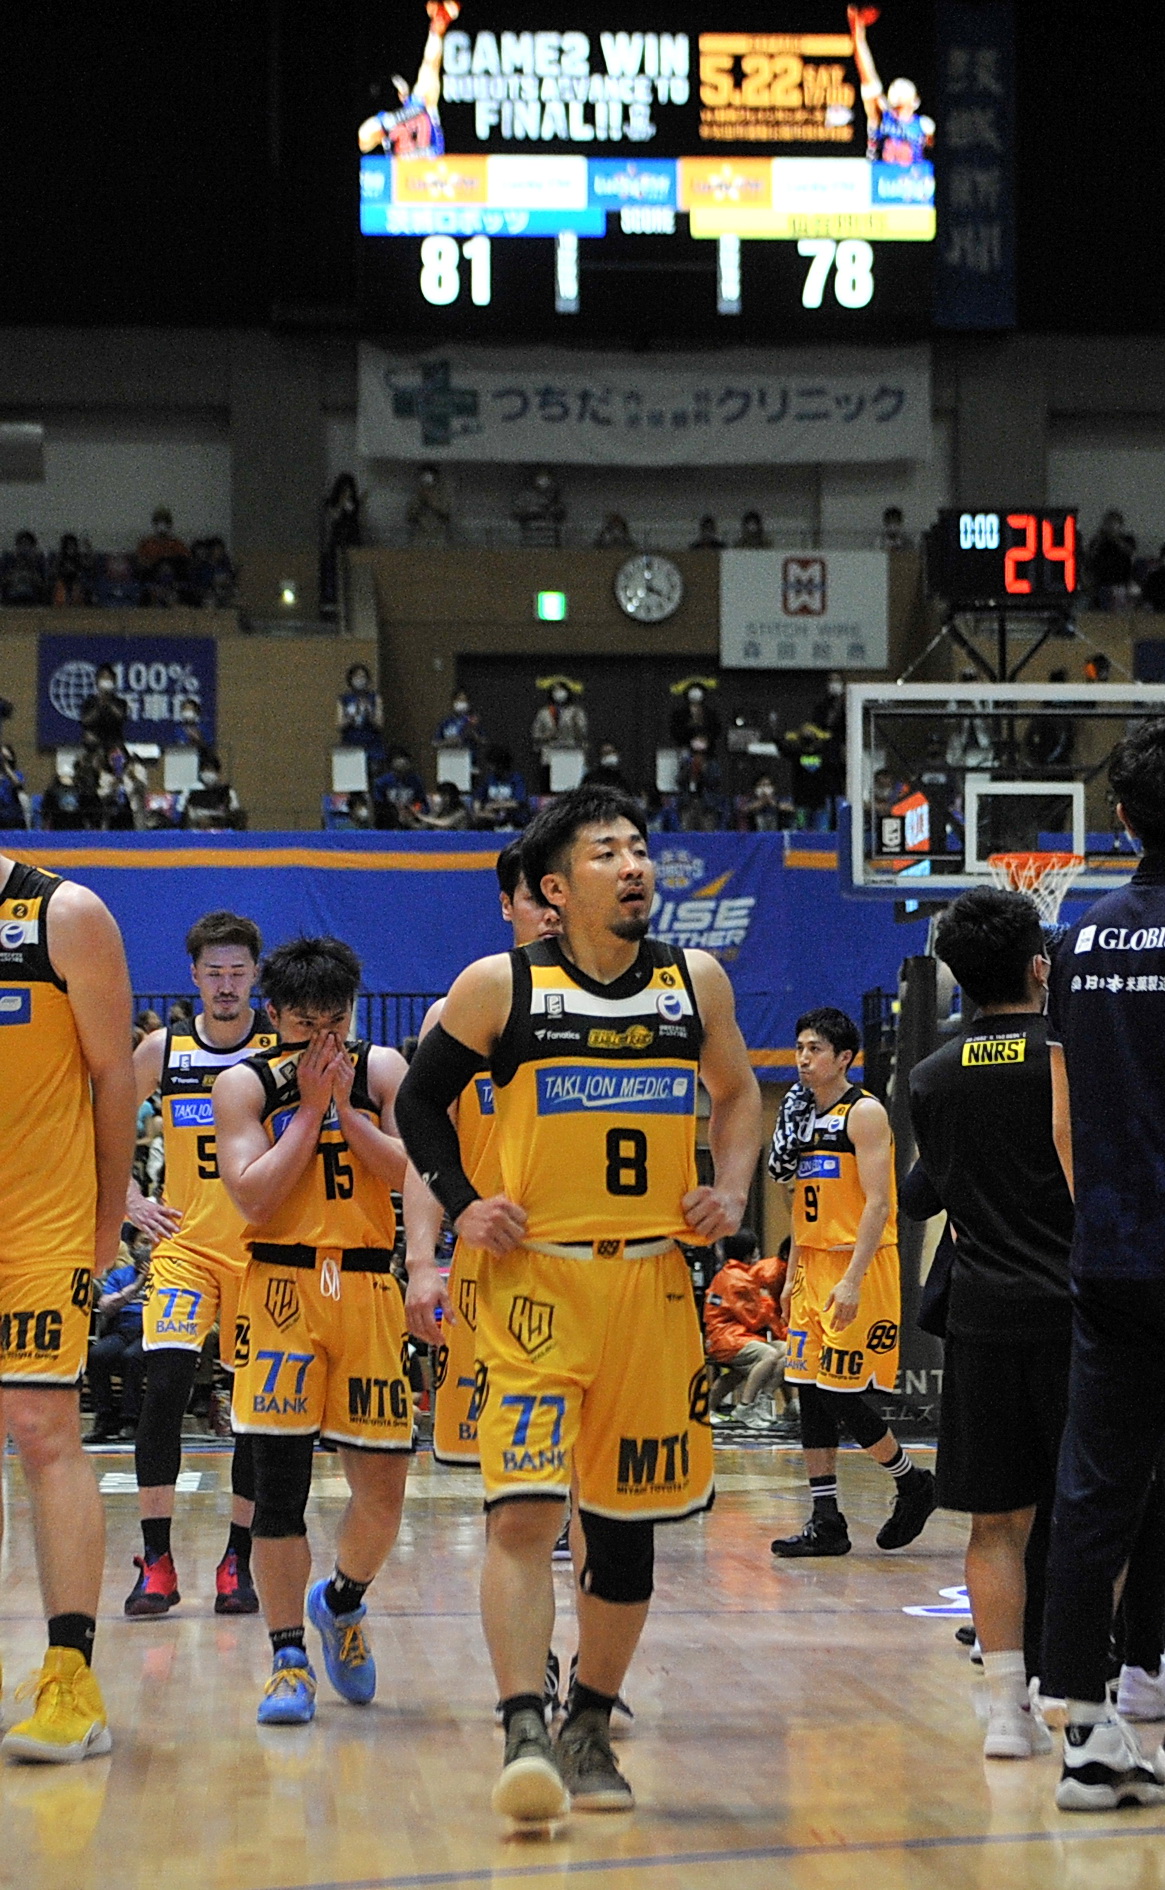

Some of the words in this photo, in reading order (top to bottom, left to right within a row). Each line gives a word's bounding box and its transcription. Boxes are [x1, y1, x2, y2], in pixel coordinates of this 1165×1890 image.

[442, 30, 590, 77] GAME2
[600, 32, 689, 78] WIN
[699, 53, 803, 108] 5.22
[420, 235, 491, 306] 81
[797, 239, 874, 309] 78
[716, 385, 905, 425] クリニック
[959, 513, 1000, 550] 0:00
[1004, 514, 1076, 594] 24
[112, 661, 200, 692] 100%
[644, 929, 747, 947] ETHER
[1098, 926, 1165, 951] GLOBI
[546, 1030, 581, 1041] Fanatics
[620, 1077, 671, 1098] MEDIC
[197, 1135, 221, 1180] 5
[316, 1141, 354, 1201] 15
[606, 1127, 648, 1196] 8
[157, 1287, 203, 1321] 77
[156, 1319, 198, 1336] BANK
[866, 1324, 898, 1350] 89
[256, 1350, 316, 1395] 77
[253, 1395, 309, 1415] BANK
[349, 1377, 409, 1419] MTG
[501, 1394, 567, 1447] 77
[502, 1448, 567, 1473] BANK
